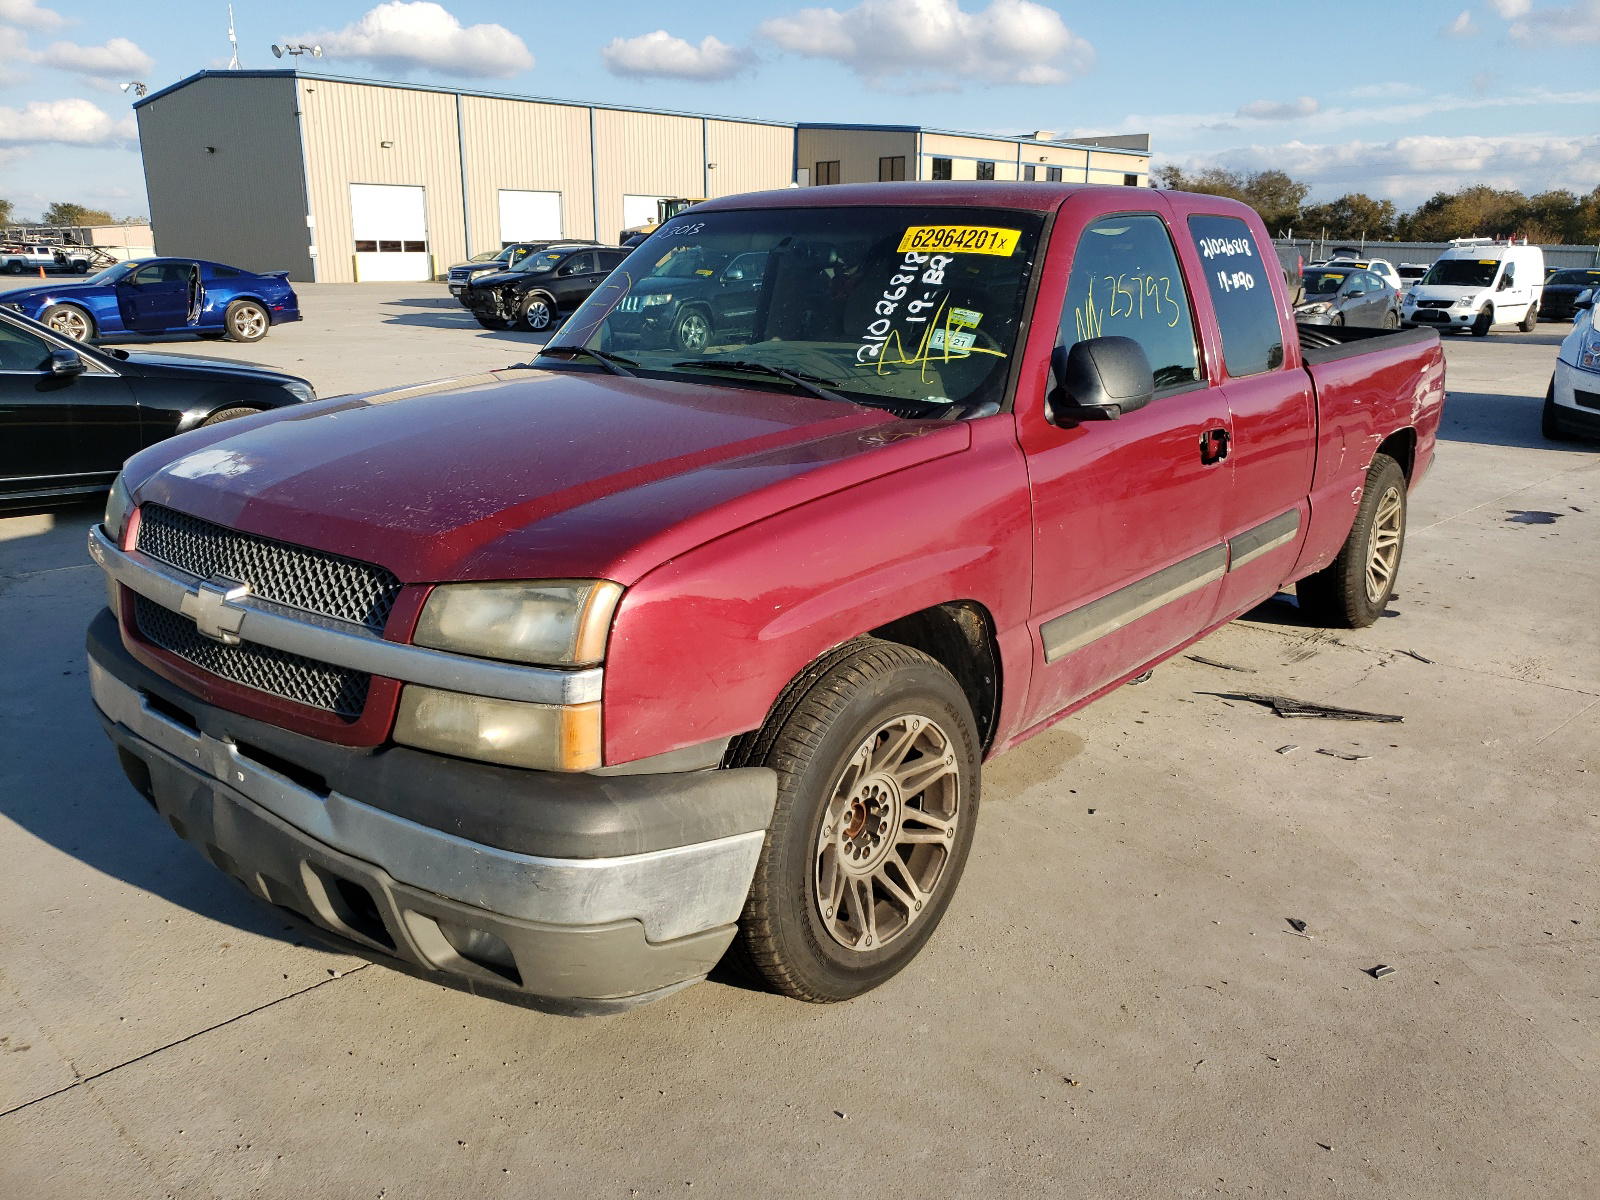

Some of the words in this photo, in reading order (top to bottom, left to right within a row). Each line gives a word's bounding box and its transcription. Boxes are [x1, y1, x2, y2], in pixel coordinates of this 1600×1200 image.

[910, 228, 999, 250] 62964201
[1199, 236, 1252, 260] 21026818
[856, 251, 929, 363] 21026818
[1103, 273, 1180, 328] 25793
